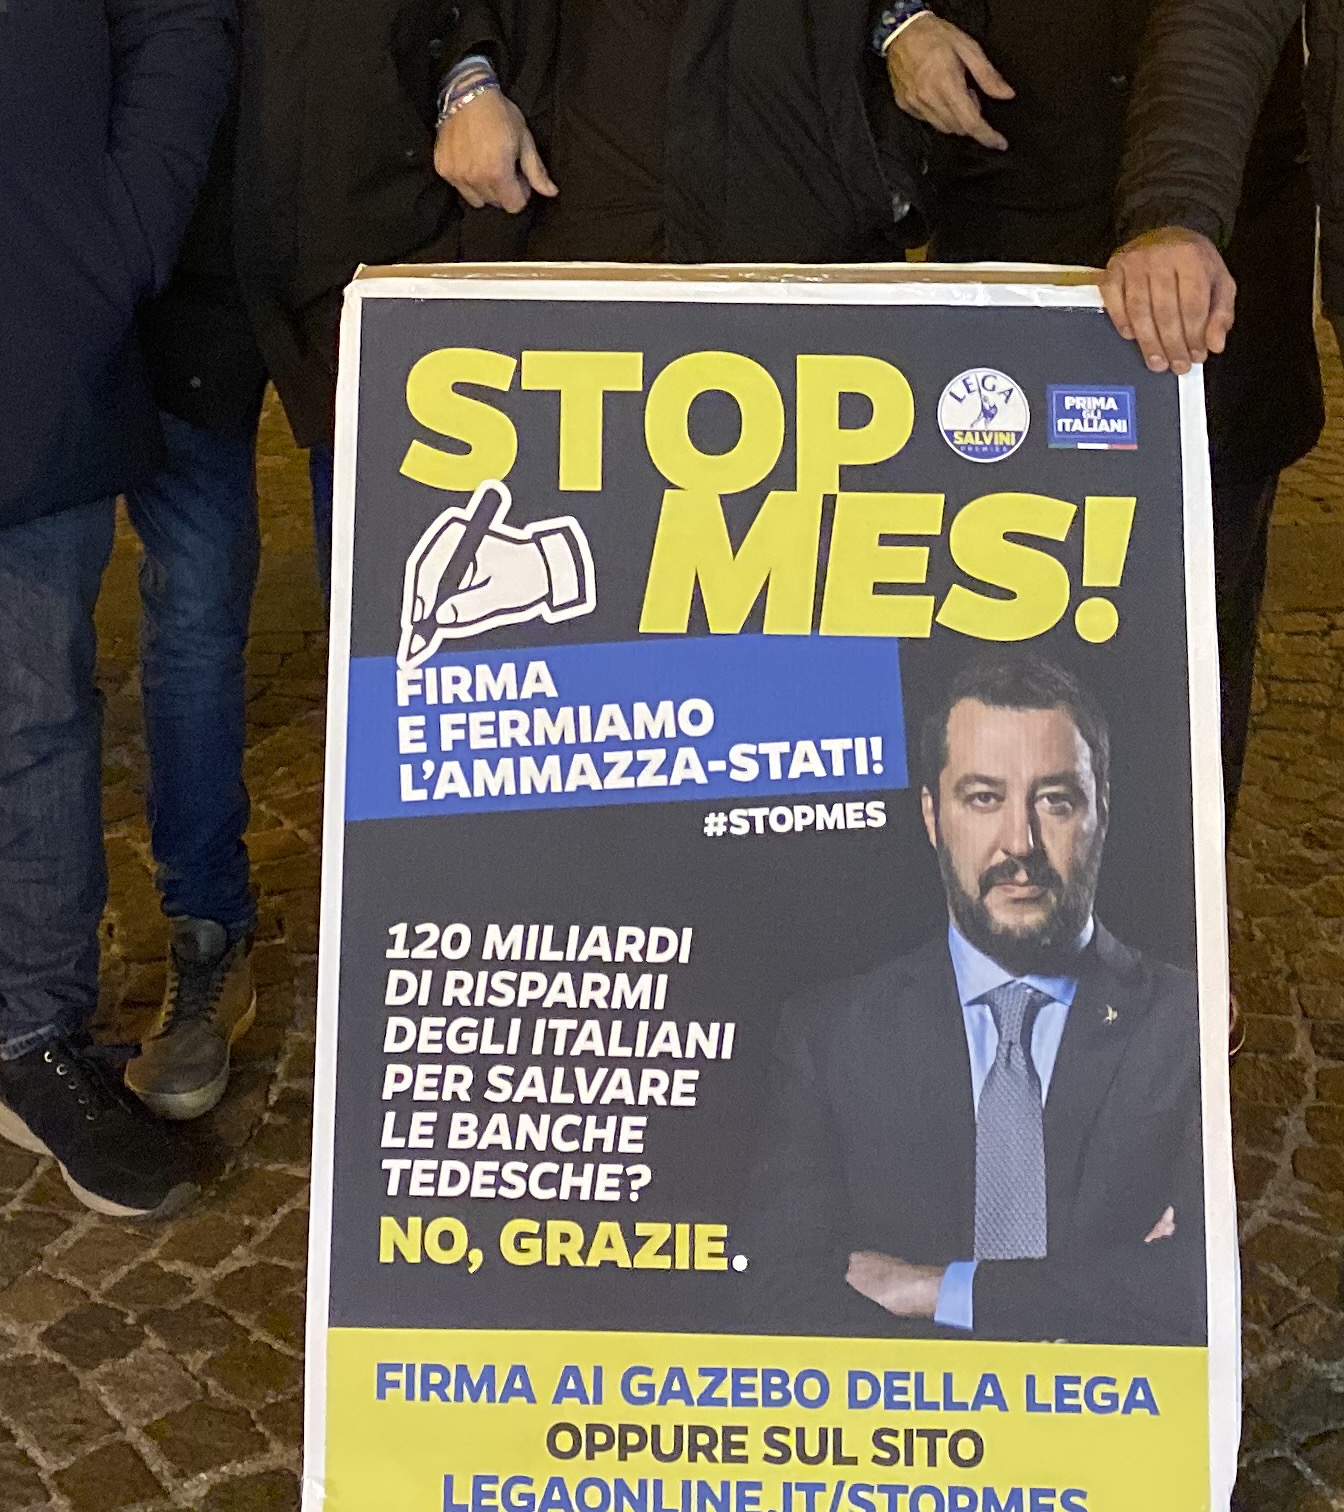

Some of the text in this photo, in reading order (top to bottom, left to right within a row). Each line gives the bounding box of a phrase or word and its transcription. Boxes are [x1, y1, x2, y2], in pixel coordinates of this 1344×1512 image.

[948, 374, 1015, 404] LEGA
[1064, 396, 1118, 410] PRIMA
[400, 347, 915, 494] STOP
[1057, 418, 1128, 432] ITALIANI
[1081, 410, 1102, 419] GLI
[953, 431, 1016, 445] SALVINI
[639, 491, 1137, 643] MES!
[397, 660, 558, 706] FIRMA
[399, 698, 716, 754] E FERMIAMO
[399, 736, 885, 802] L'AMMAZZA-STATI!
[704, 801, 886, 836] #STOPMES
[386, 923, 692, 963] 120 MILIARDI
[385, 970, 668, 1009] DI RISPARMI
[384, 1017, 735, 1059] DEGLI ITALIANI
[382, 1064, 699, 1106] PER SALVARE
[381, 1112, 647, 1153] LE BANCHE
[382, 1159, 651, 1201] TEDESCHE?
[379, 1217, 749, 1274] NO, GRAZIE.
[378, 1364, 1157, 1414] FIRMA AI GAZEBO DELLA LEGA
[547, 1423, 983, 1467] OPPURE SUL SITO
